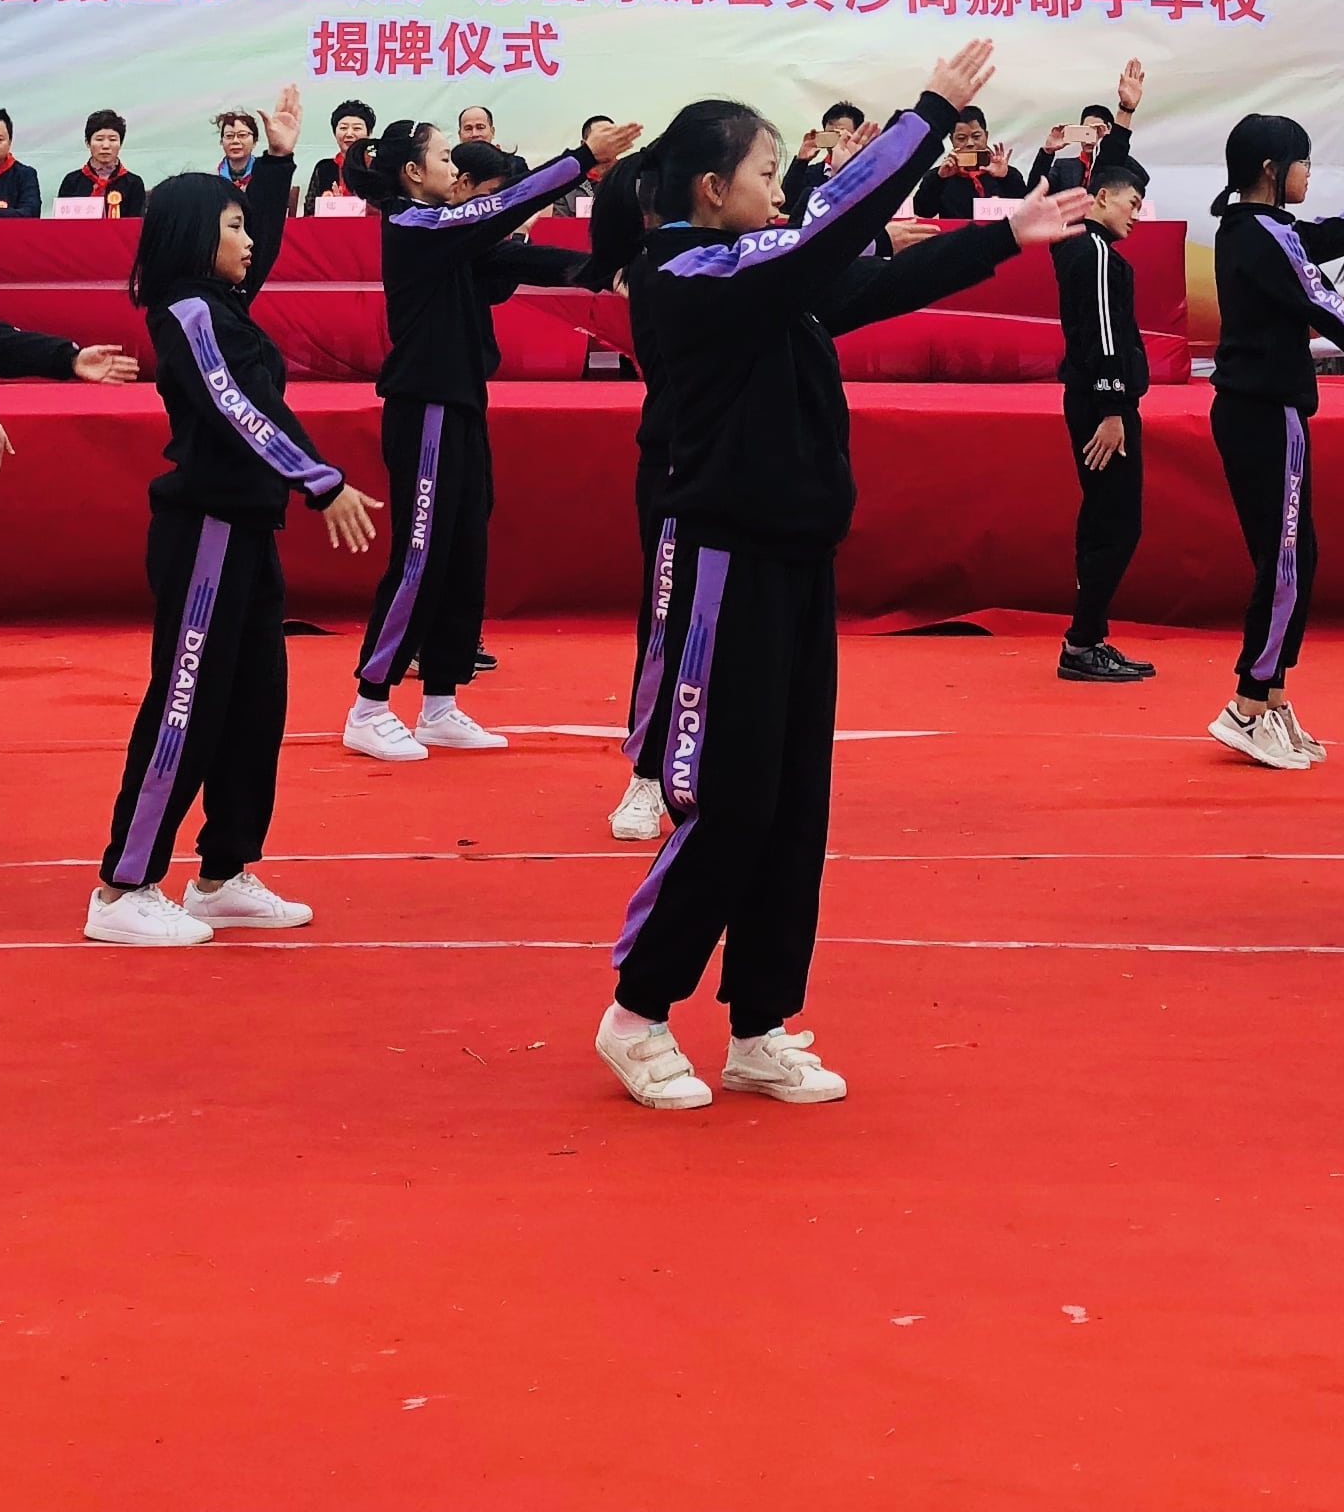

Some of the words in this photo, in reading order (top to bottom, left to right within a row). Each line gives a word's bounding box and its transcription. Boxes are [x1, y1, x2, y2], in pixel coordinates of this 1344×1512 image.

[311, 18, 560, 78] 揭牌仪式
[438, 197, 504, 221] DCANE
[208, 368, 275, 446] DCANE
[412, 478, 433, 550] DCANE
[1284, 474, 1301, 548] DCANE
[657, 542, 674, 620] DCANE
[167, 629, 205, 729] DCANE
[672, 683, 701, 805] DCANE
